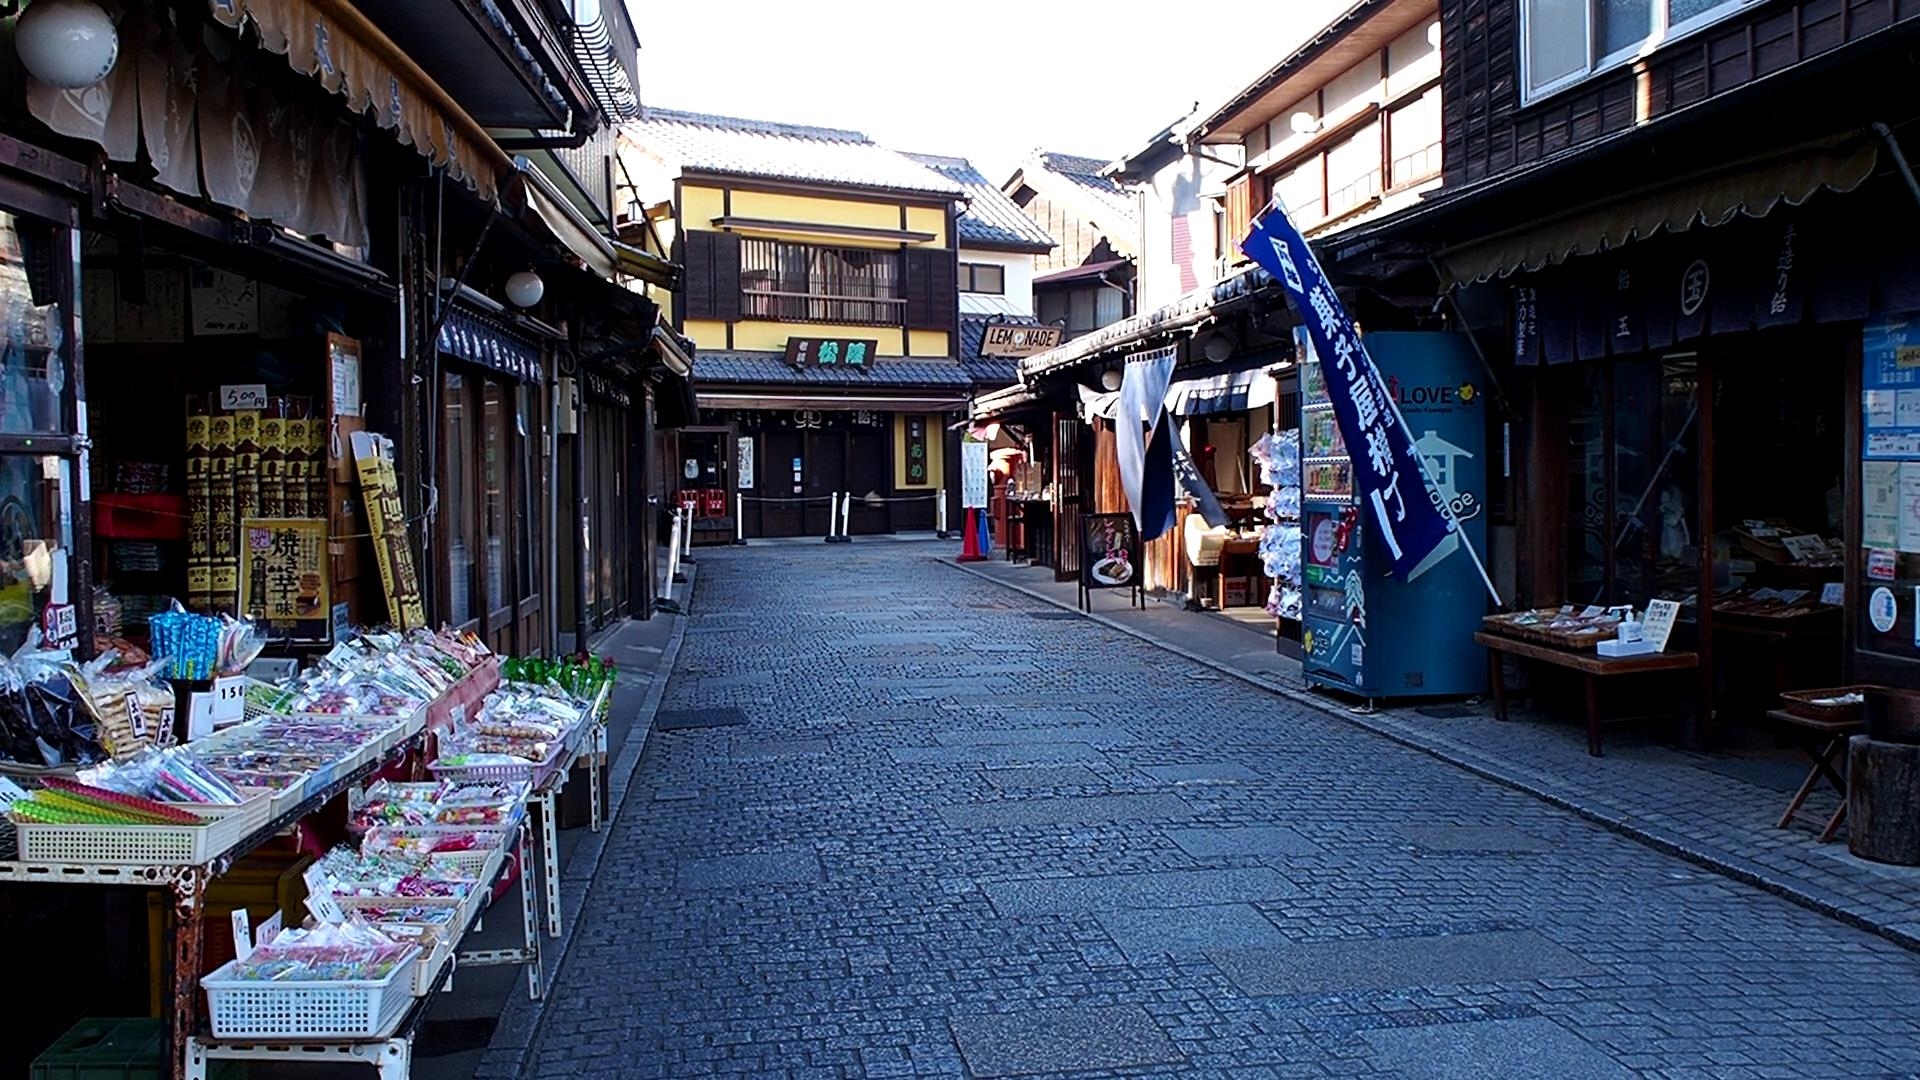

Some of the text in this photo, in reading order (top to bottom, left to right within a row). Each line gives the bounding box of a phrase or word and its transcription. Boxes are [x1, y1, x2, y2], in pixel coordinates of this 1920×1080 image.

[989, 328, 1055, 347] LEMONADE
[1309, 286, 1406, 522] 菓子屋横丁
[1401, 387, 1453, 404] LOVE
[910, 442, 924, 478] あめ
[270, 527, 300, 616] 焼き芋味
